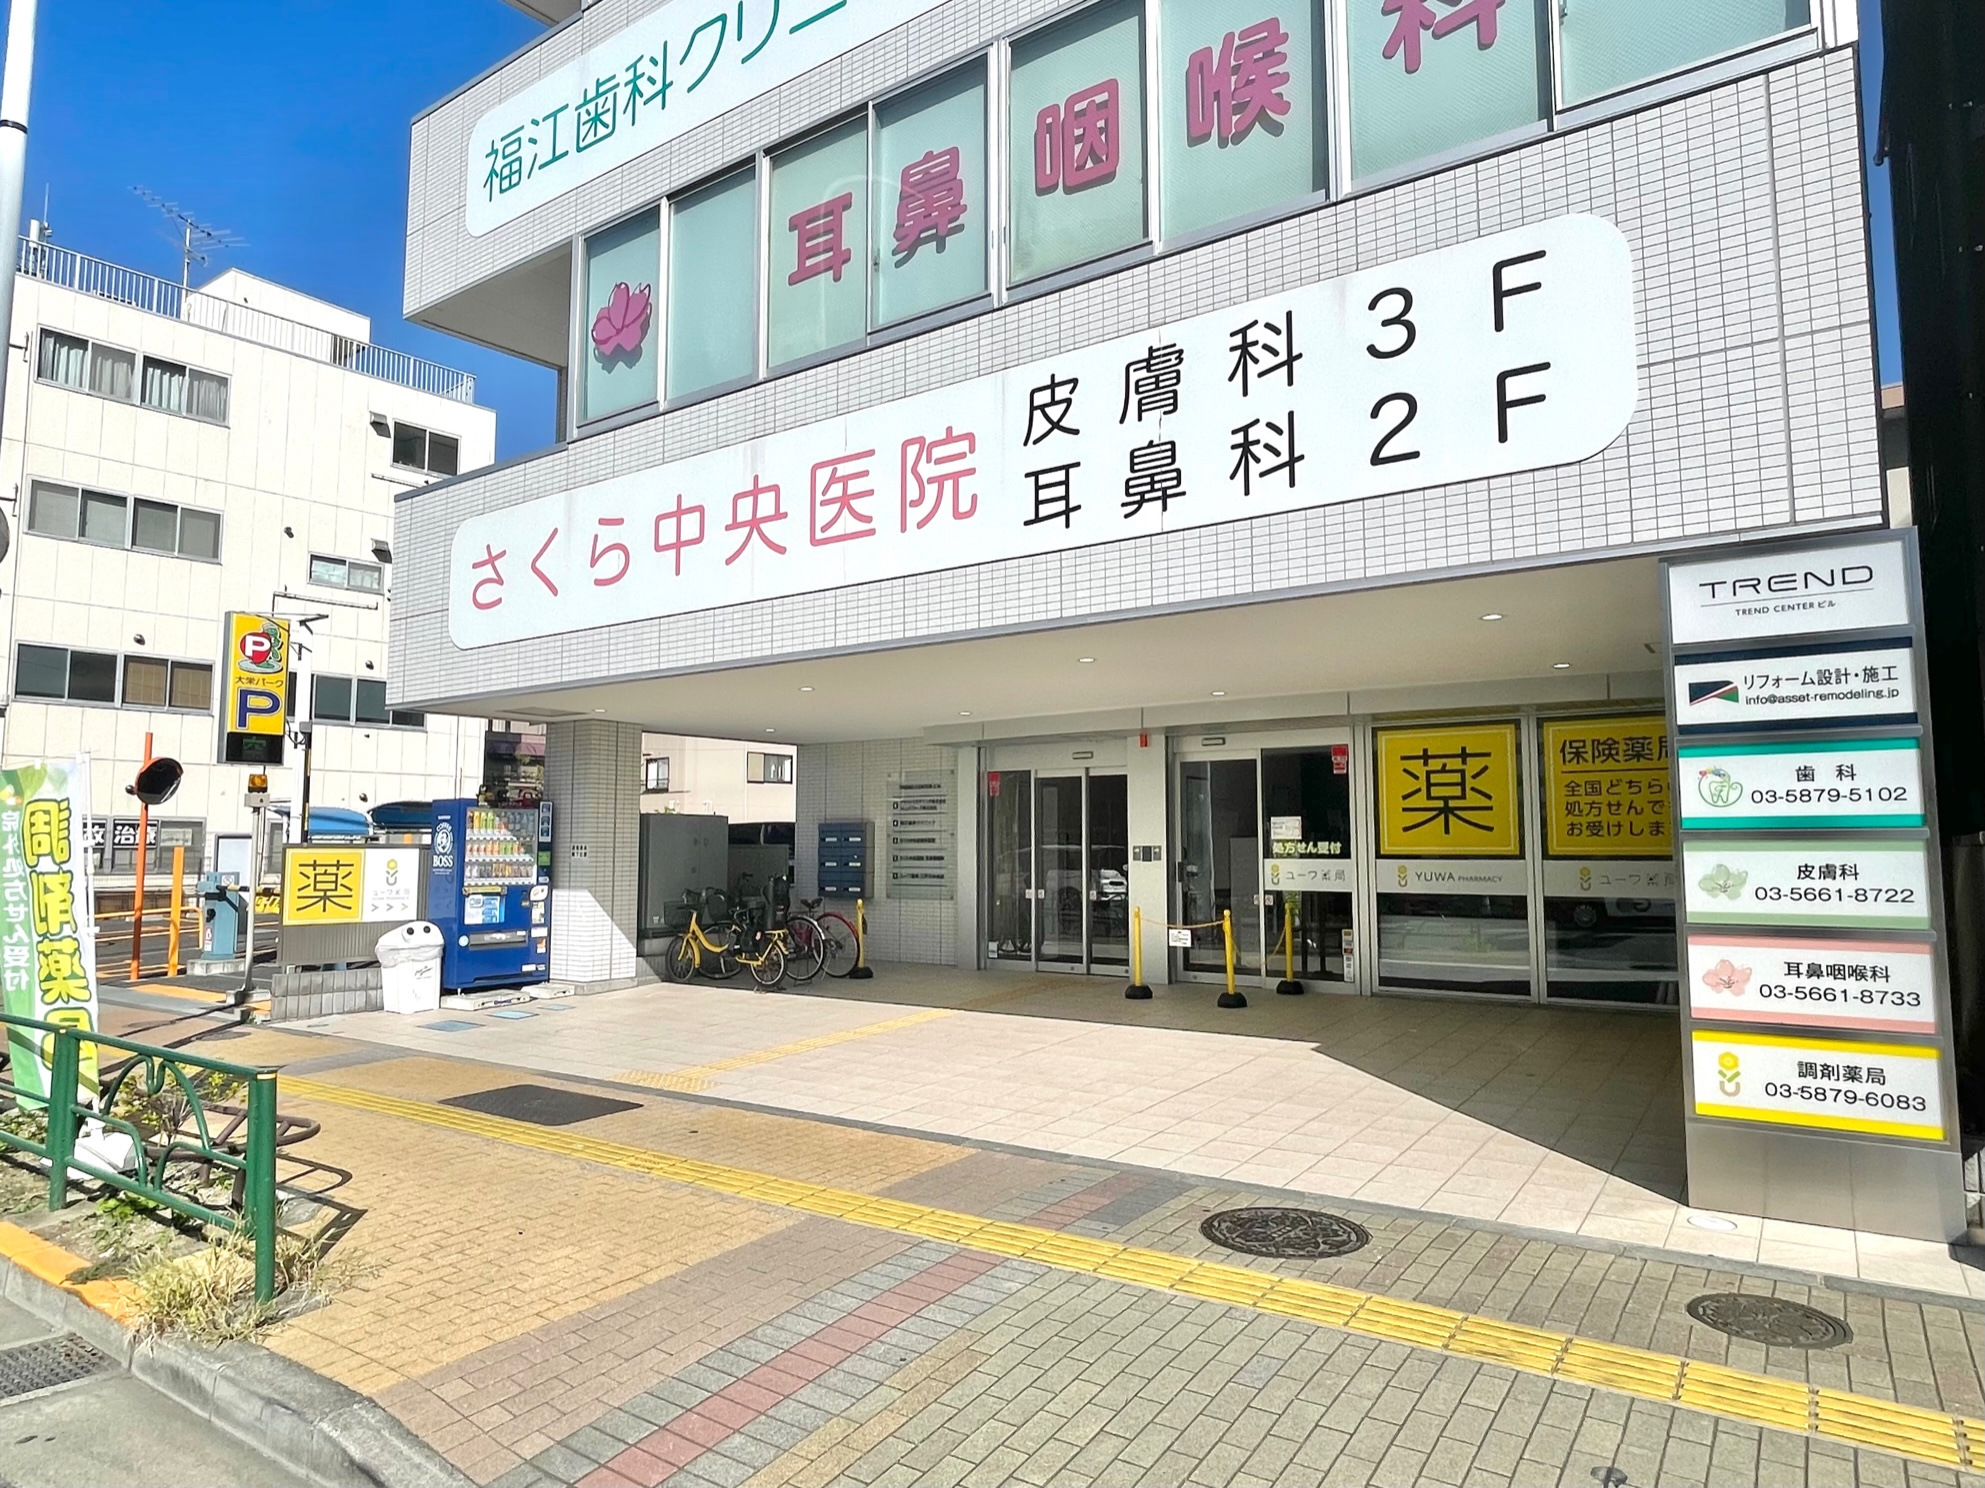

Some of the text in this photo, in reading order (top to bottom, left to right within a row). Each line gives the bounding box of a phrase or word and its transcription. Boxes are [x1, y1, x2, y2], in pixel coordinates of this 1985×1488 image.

[1023, 310, 1303, 447] 皮膚科
[1023, 411, 1305, 529] 耳鼻科
[471, 425, 978, 611] さくら中央医院
[1699, 565, 1874, 599] TREND
[1735, 600, 1836, 616] TREND CENTER ビル
[244, 634, 271, 657] P
[235, 676, 284, 688] 大栄パーク
[1744, 665, 1899, 690] リフォーム設計・施工
[1745, 687, 1900, 706] info@asset-remodeling.jp
[236, 687, 282, 730] P
[1400, 746, 1494, 835] 薬
[1564, 778, 1671, 797] 全国どちら
[1751, 787, 1908, 804] 03-5879-5102
[1564, 800, 1672, 817] 処方せんで
[1566, 820, 1672, 838] お受けしま
[432, 855, 453, 867] BOSS
[1797, 863, 1860, 881] 皮膚科
[296, 859, 354, 913] 薬
[1415, 871, 1503, 883] YUWA PHARMACY
[1754, 886, 1915, 904] 03-5661-8722
[1784, 961, 1891, 983] 耳鼻咽喉科
[1759, 983, 1921, 1007] 03-5661-8733
[1797, 1061, 1886, 1086] 調剤薬局
[1764, 1081, 1927, 1112] 03-5879-6083
